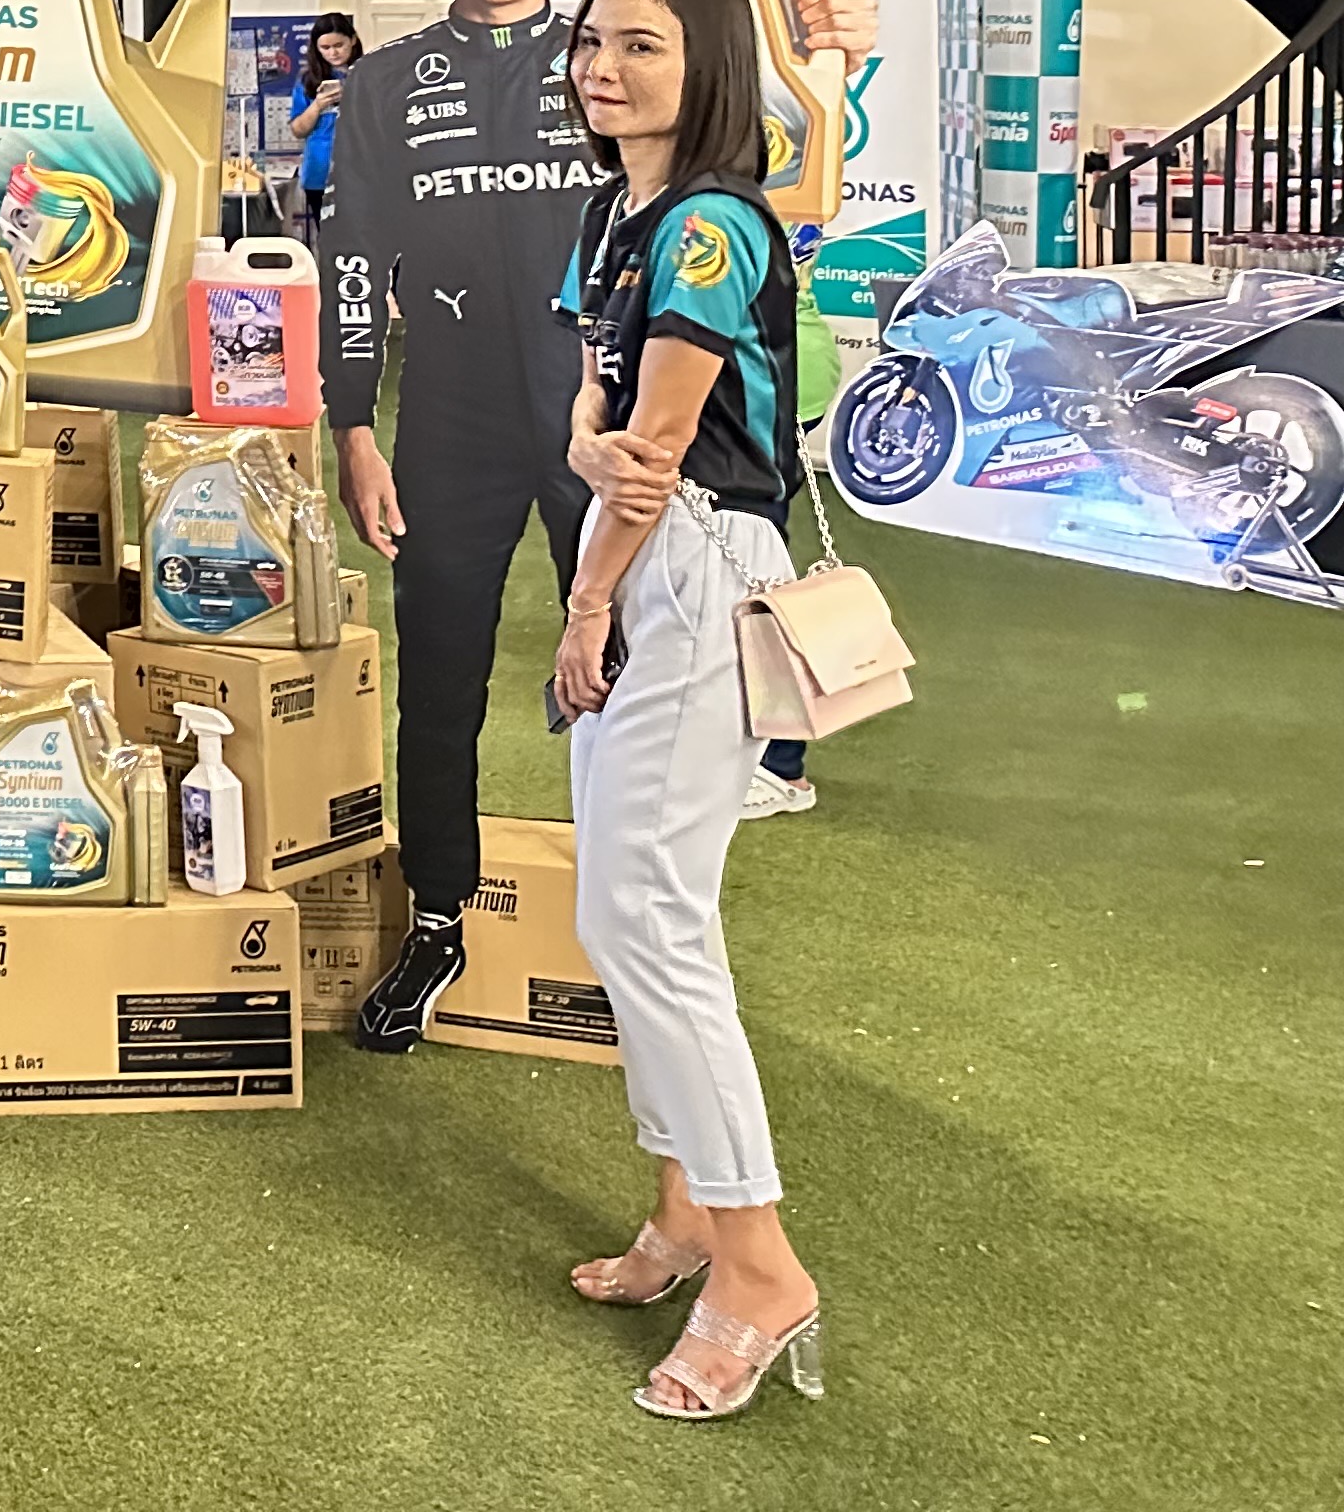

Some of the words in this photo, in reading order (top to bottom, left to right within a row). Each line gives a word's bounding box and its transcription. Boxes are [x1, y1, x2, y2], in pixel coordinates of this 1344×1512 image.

[426, 101, 468, 119] UBS
[412, 160, 612, 200] PETRONAS
[841, 182, 916, 203] ONAS
[335, 255, 375, 360] INEOS
[965, 407, 1042, 437] PETRONAS
[989, 461, 1078, 485] BARRACUDA
[32, 797, 41, 807] E
[43, 798, 83, 808] DIESEL
[479, 877, 517, 890] ONAS
[464, 891, 518, 913] NTIUM
[231, 964, 281, 973] PETRONAS
[129, 1019, 177, 1032] 5W-40
[0, 1055, 8, 1070] 1
[15, 1054, 44, 1070] ลิตร
